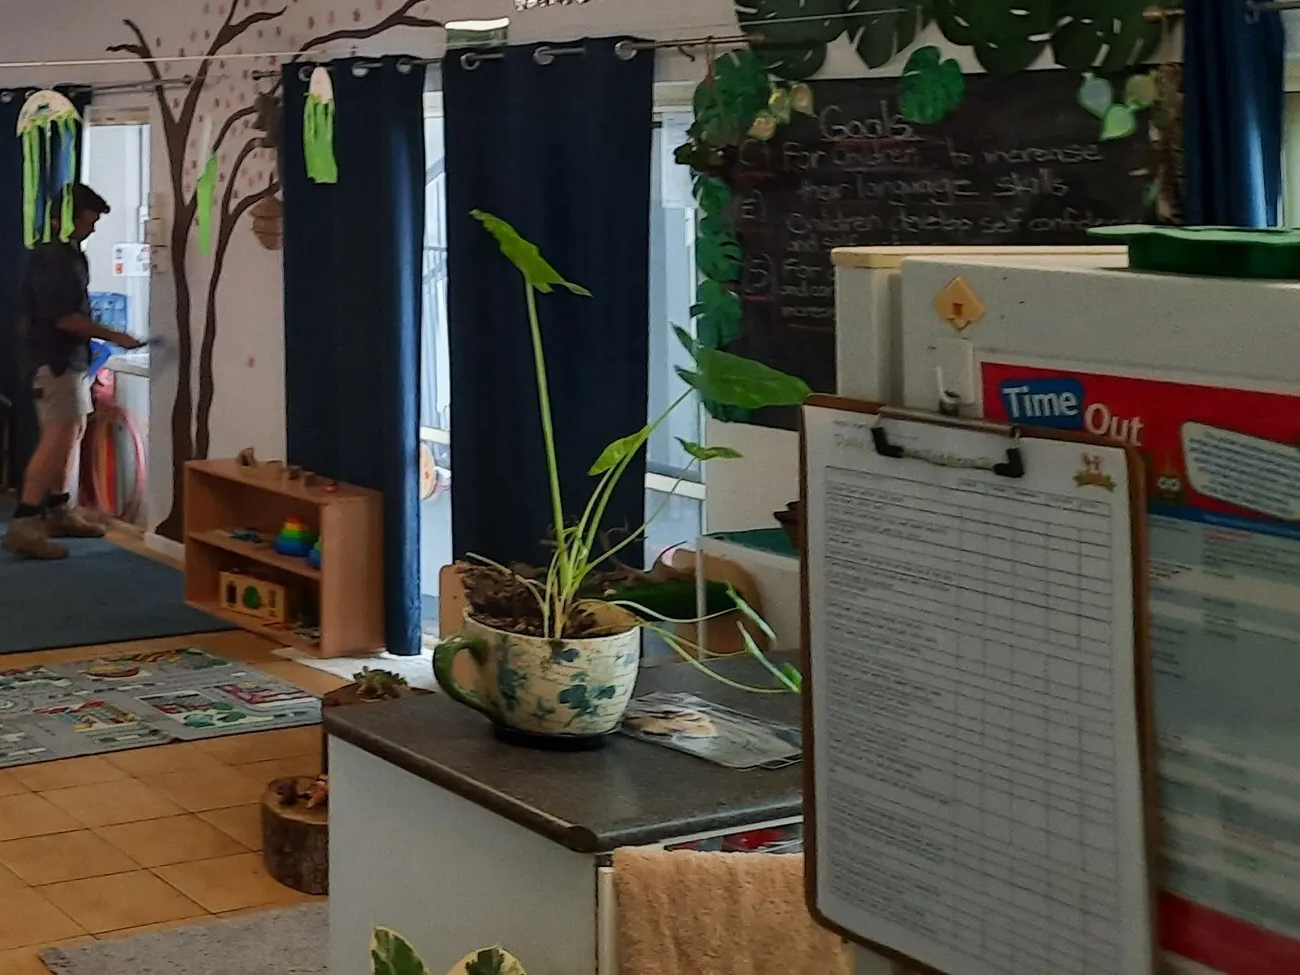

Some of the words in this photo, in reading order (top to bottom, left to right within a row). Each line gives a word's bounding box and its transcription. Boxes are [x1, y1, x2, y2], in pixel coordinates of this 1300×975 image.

[819, 99, 917, 140] Goals
[856, 174, 980, 207] language
[994, 168, 1070, 198] skills
[1001, 384, 1079, 419] Time
[1083, 401, 1145, 447] Out
